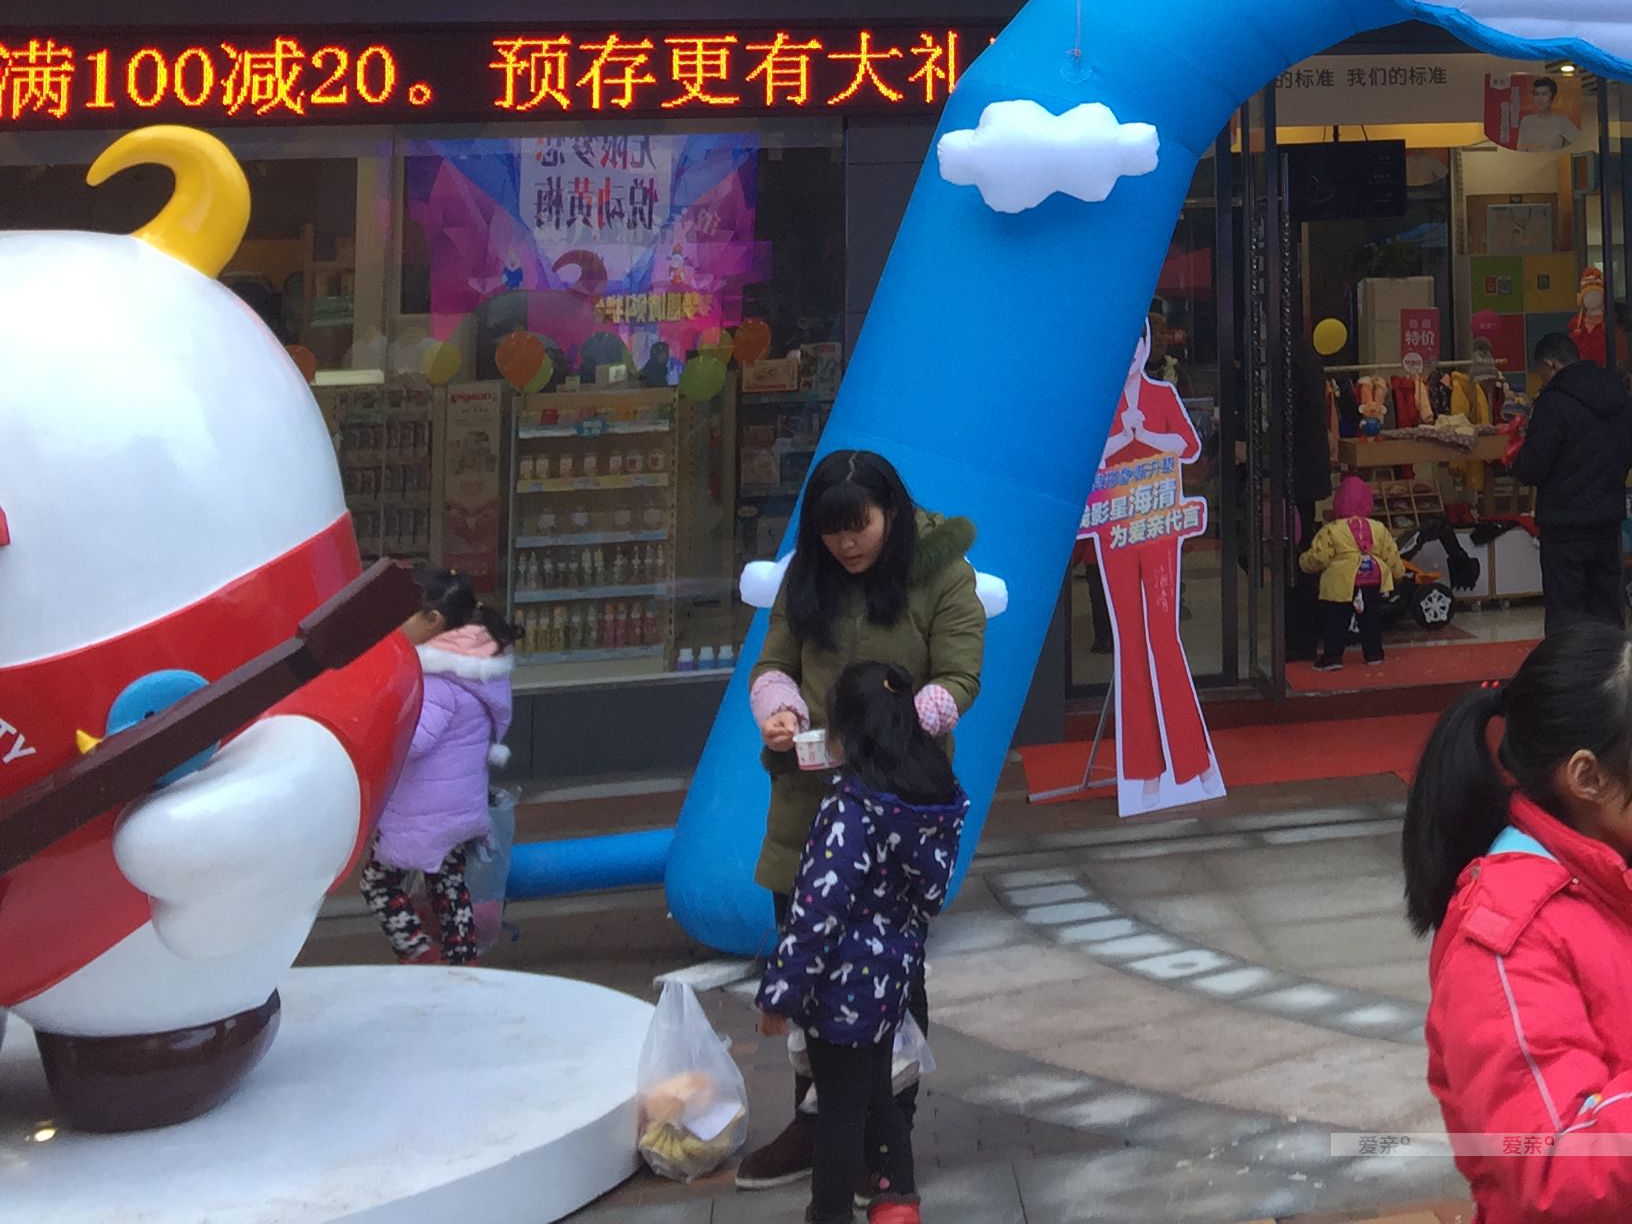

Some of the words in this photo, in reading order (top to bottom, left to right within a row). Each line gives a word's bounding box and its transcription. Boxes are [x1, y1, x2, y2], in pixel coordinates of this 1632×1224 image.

[1346, 66, 1448, 88] 我们的标准
[1109, 505, 1202, 550] 为爱亲代言
